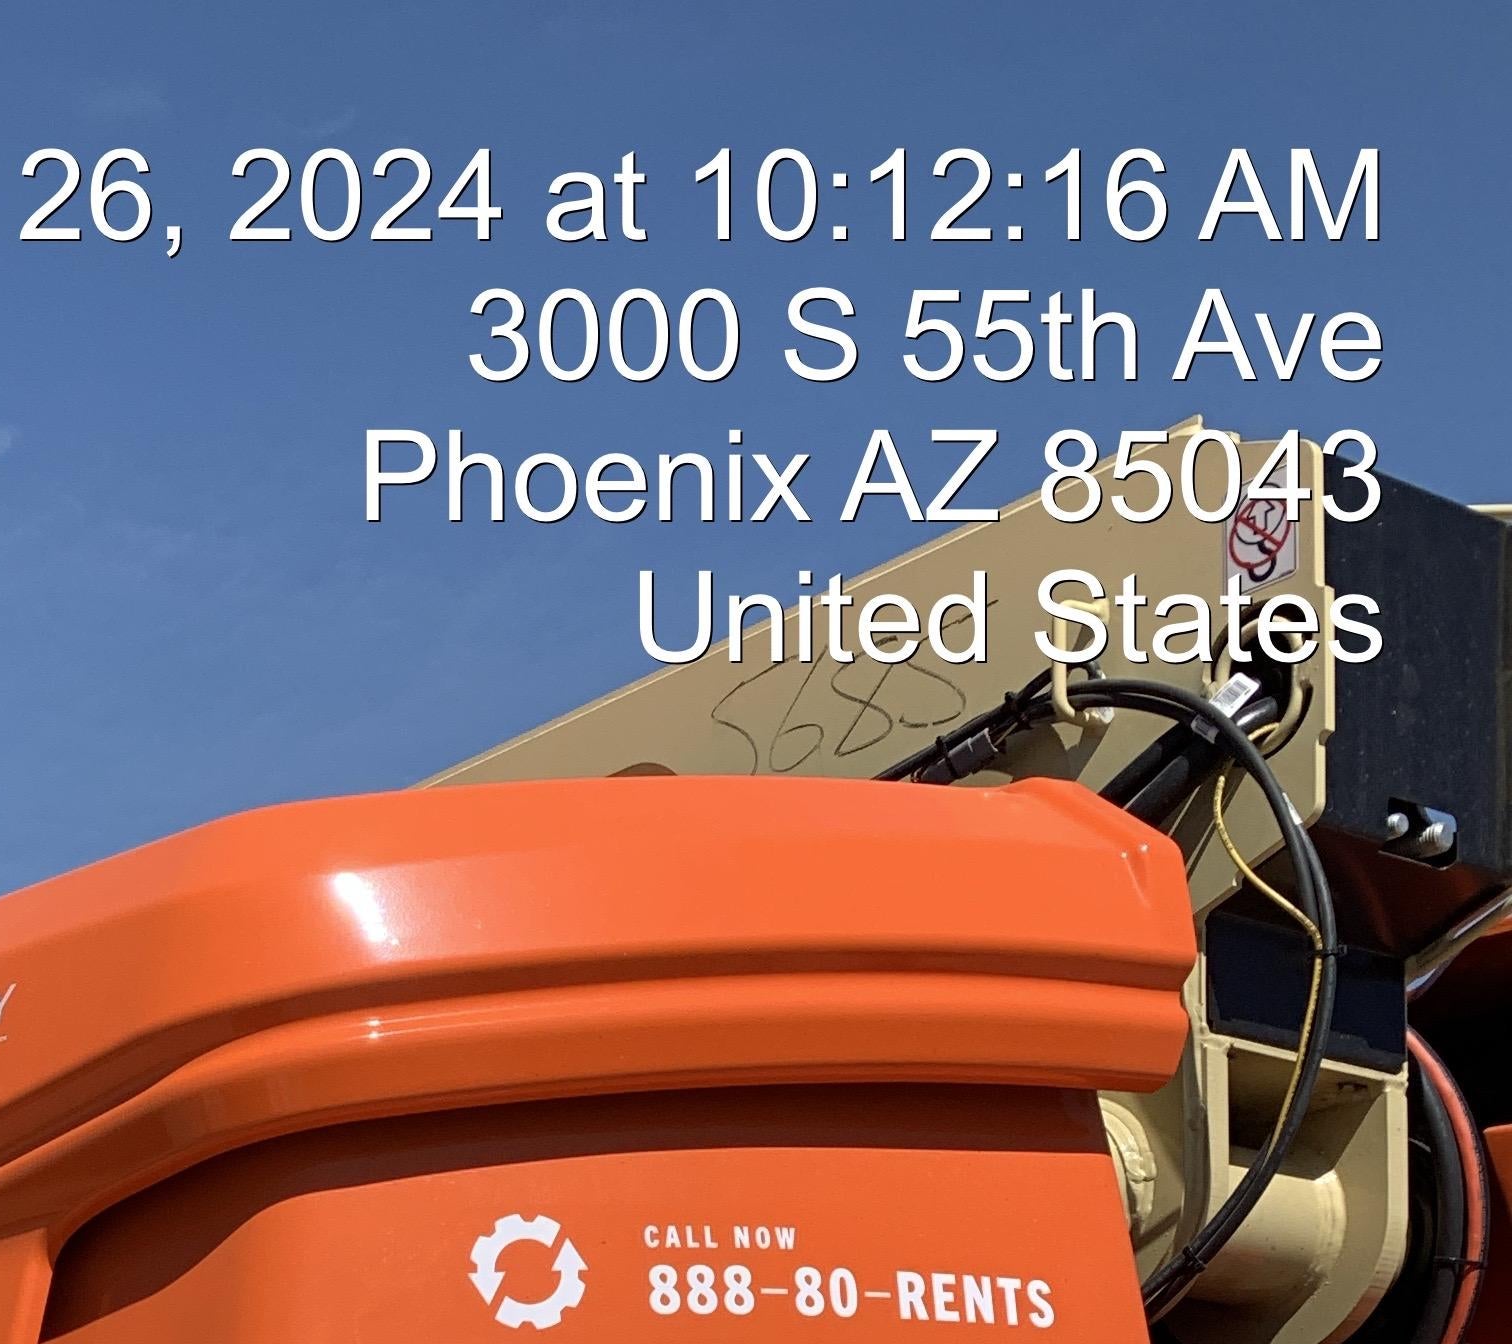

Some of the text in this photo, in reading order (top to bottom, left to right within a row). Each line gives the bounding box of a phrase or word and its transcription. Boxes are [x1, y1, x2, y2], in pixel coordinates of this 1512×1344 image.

[643, 1225, 797, 1250] CALL NOW
[648, 1264, 1056, 1329] 888-80-RENTS
